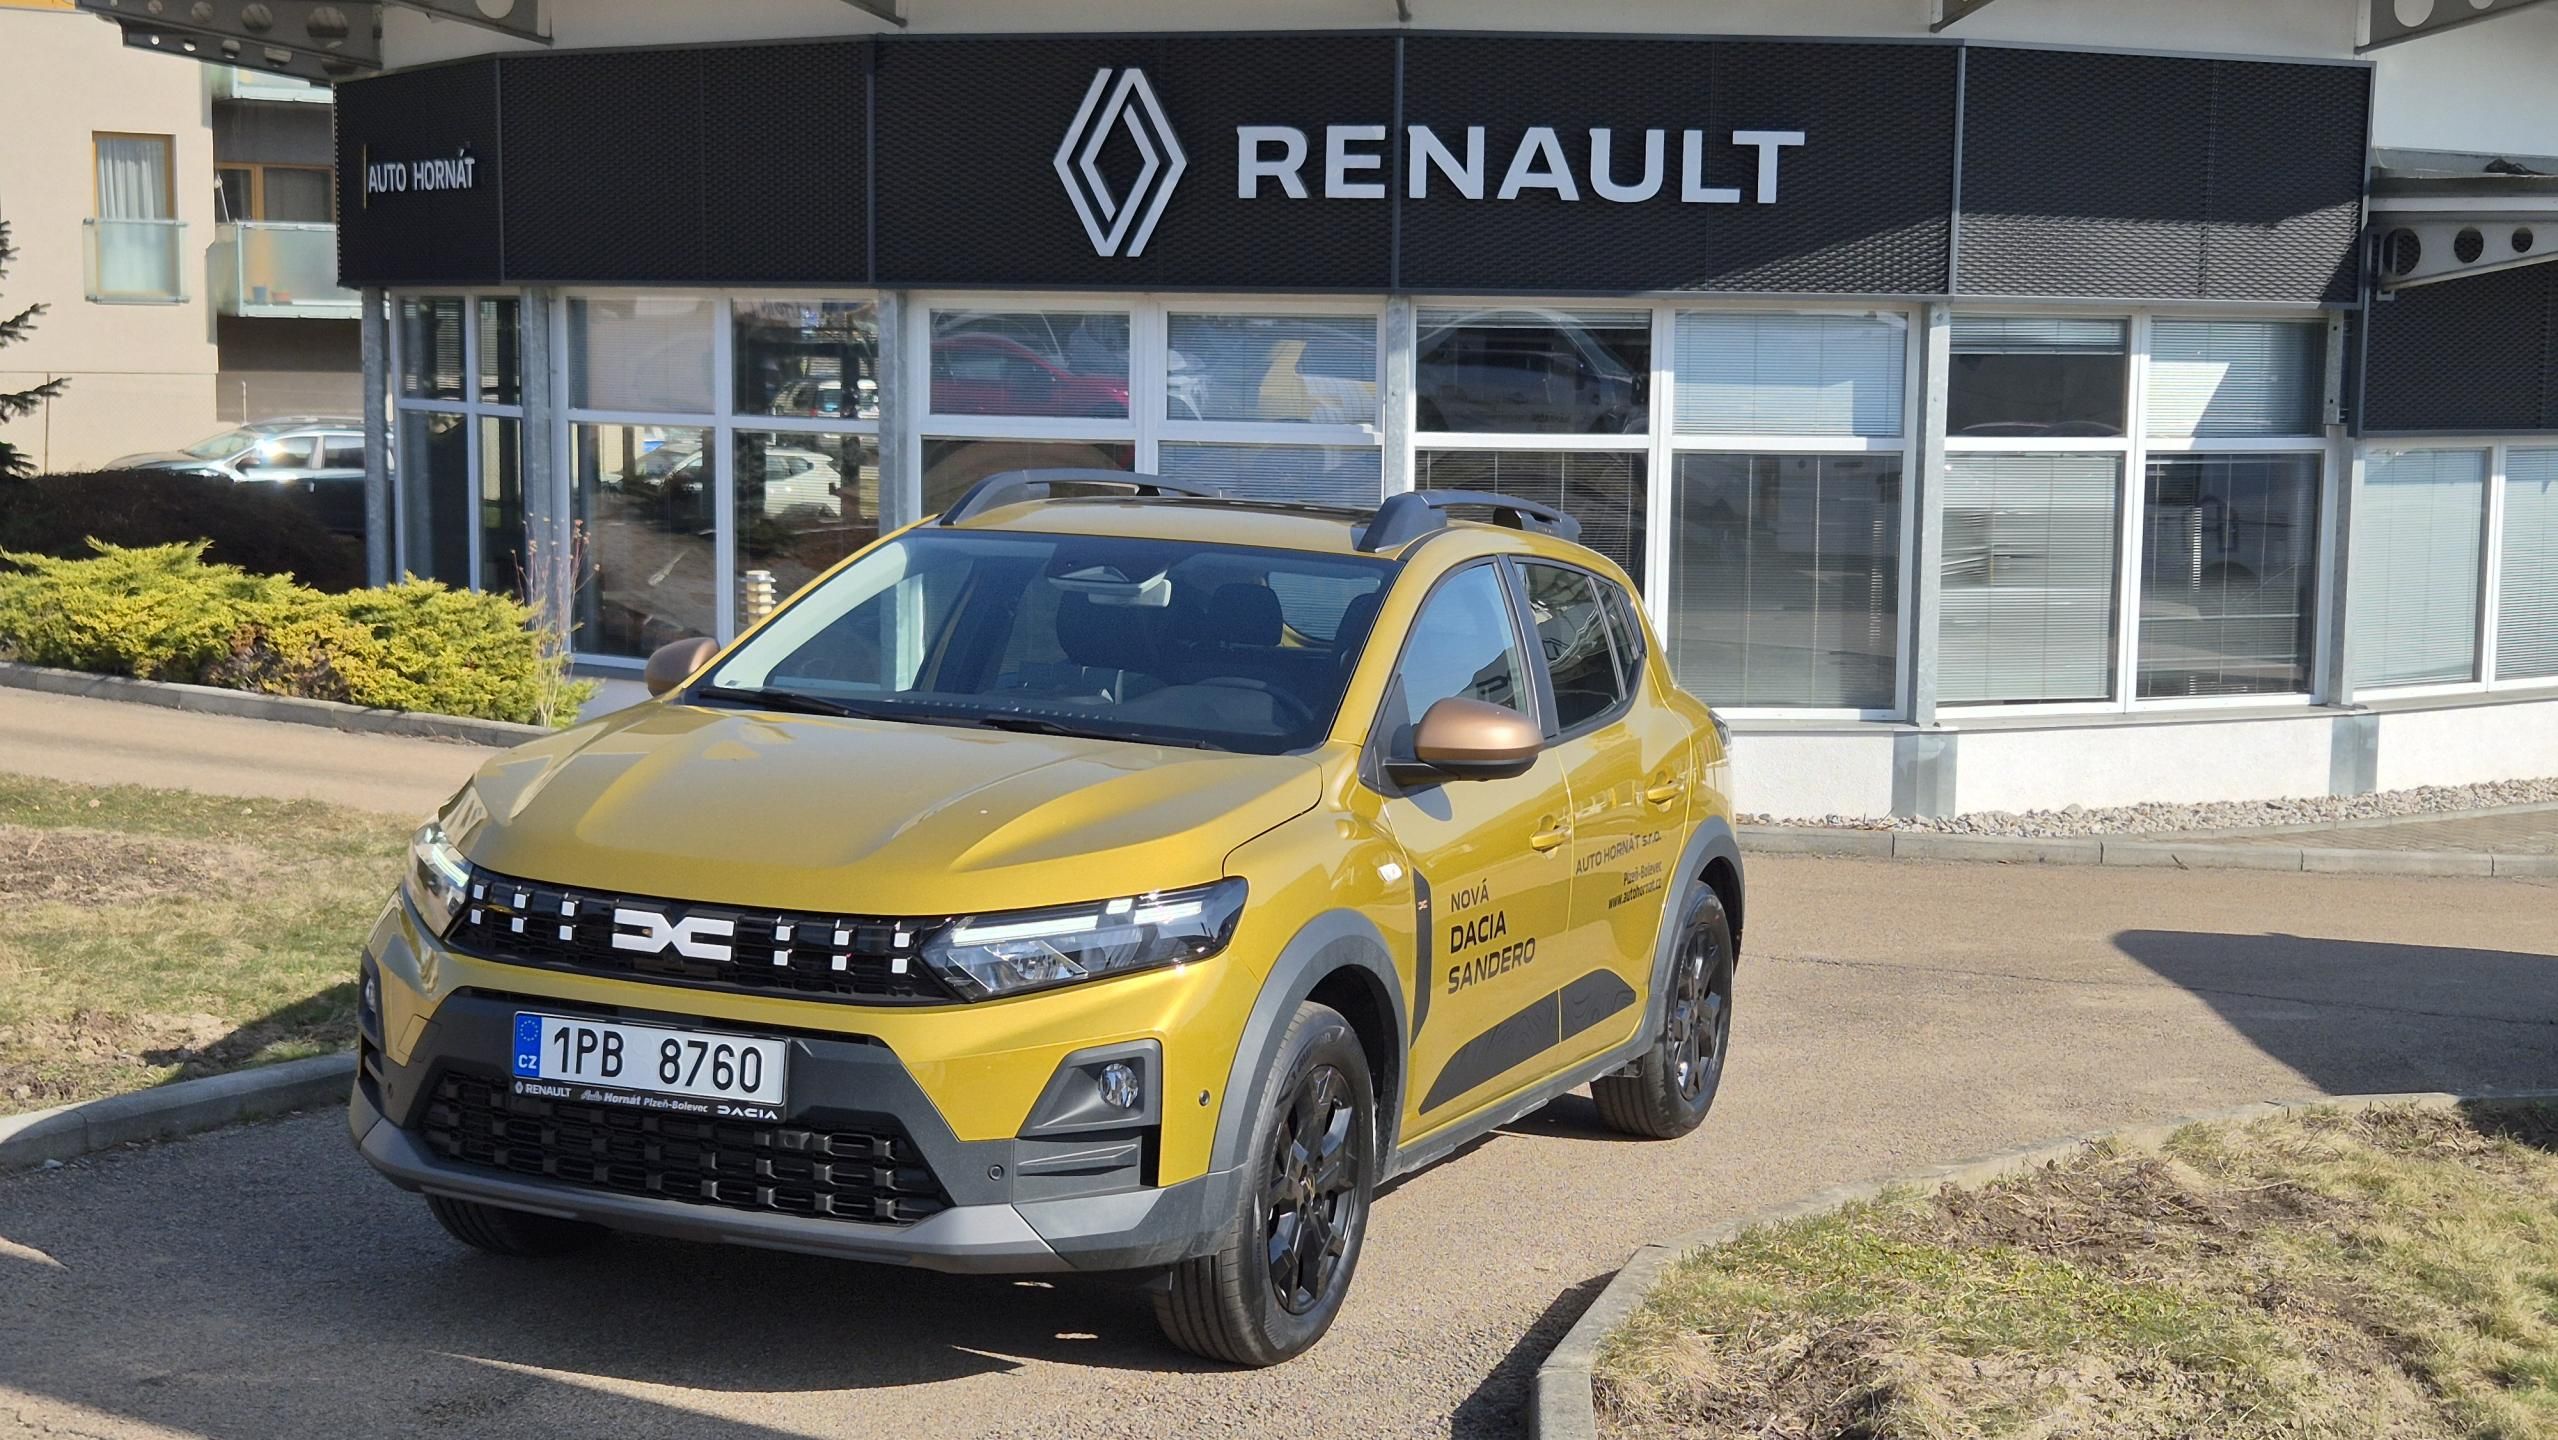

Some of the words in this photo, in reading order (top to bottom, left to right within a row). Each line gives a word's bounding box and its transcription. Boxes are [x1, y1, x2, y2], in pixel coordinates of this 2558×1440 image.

[368, 161, 407, 193] AUTO
[413, 148, 475, 191] HORNÁT
[1236, 124, 1806, 204] RENAULT
[1575, 849, 1603, 875] AUTO
[1603, 831, 1641, 864] HORNÁT
[1451, 877, 1489, 912] NOVÁ
[1450, 910, 1507, 954] DACIA
[1447, 937, 1536, 995] SANDERO
[517, 1054, 538, 1069] CZ
[553, 1026, 624, 1078] 1PB
[658, 1037, 763, 1093] 8760
[525, 1083, 572, 1098] RENAULT
[604, 1092, 642, 1106] Hornát
[717, 1104, 778, 1120] DACIA
